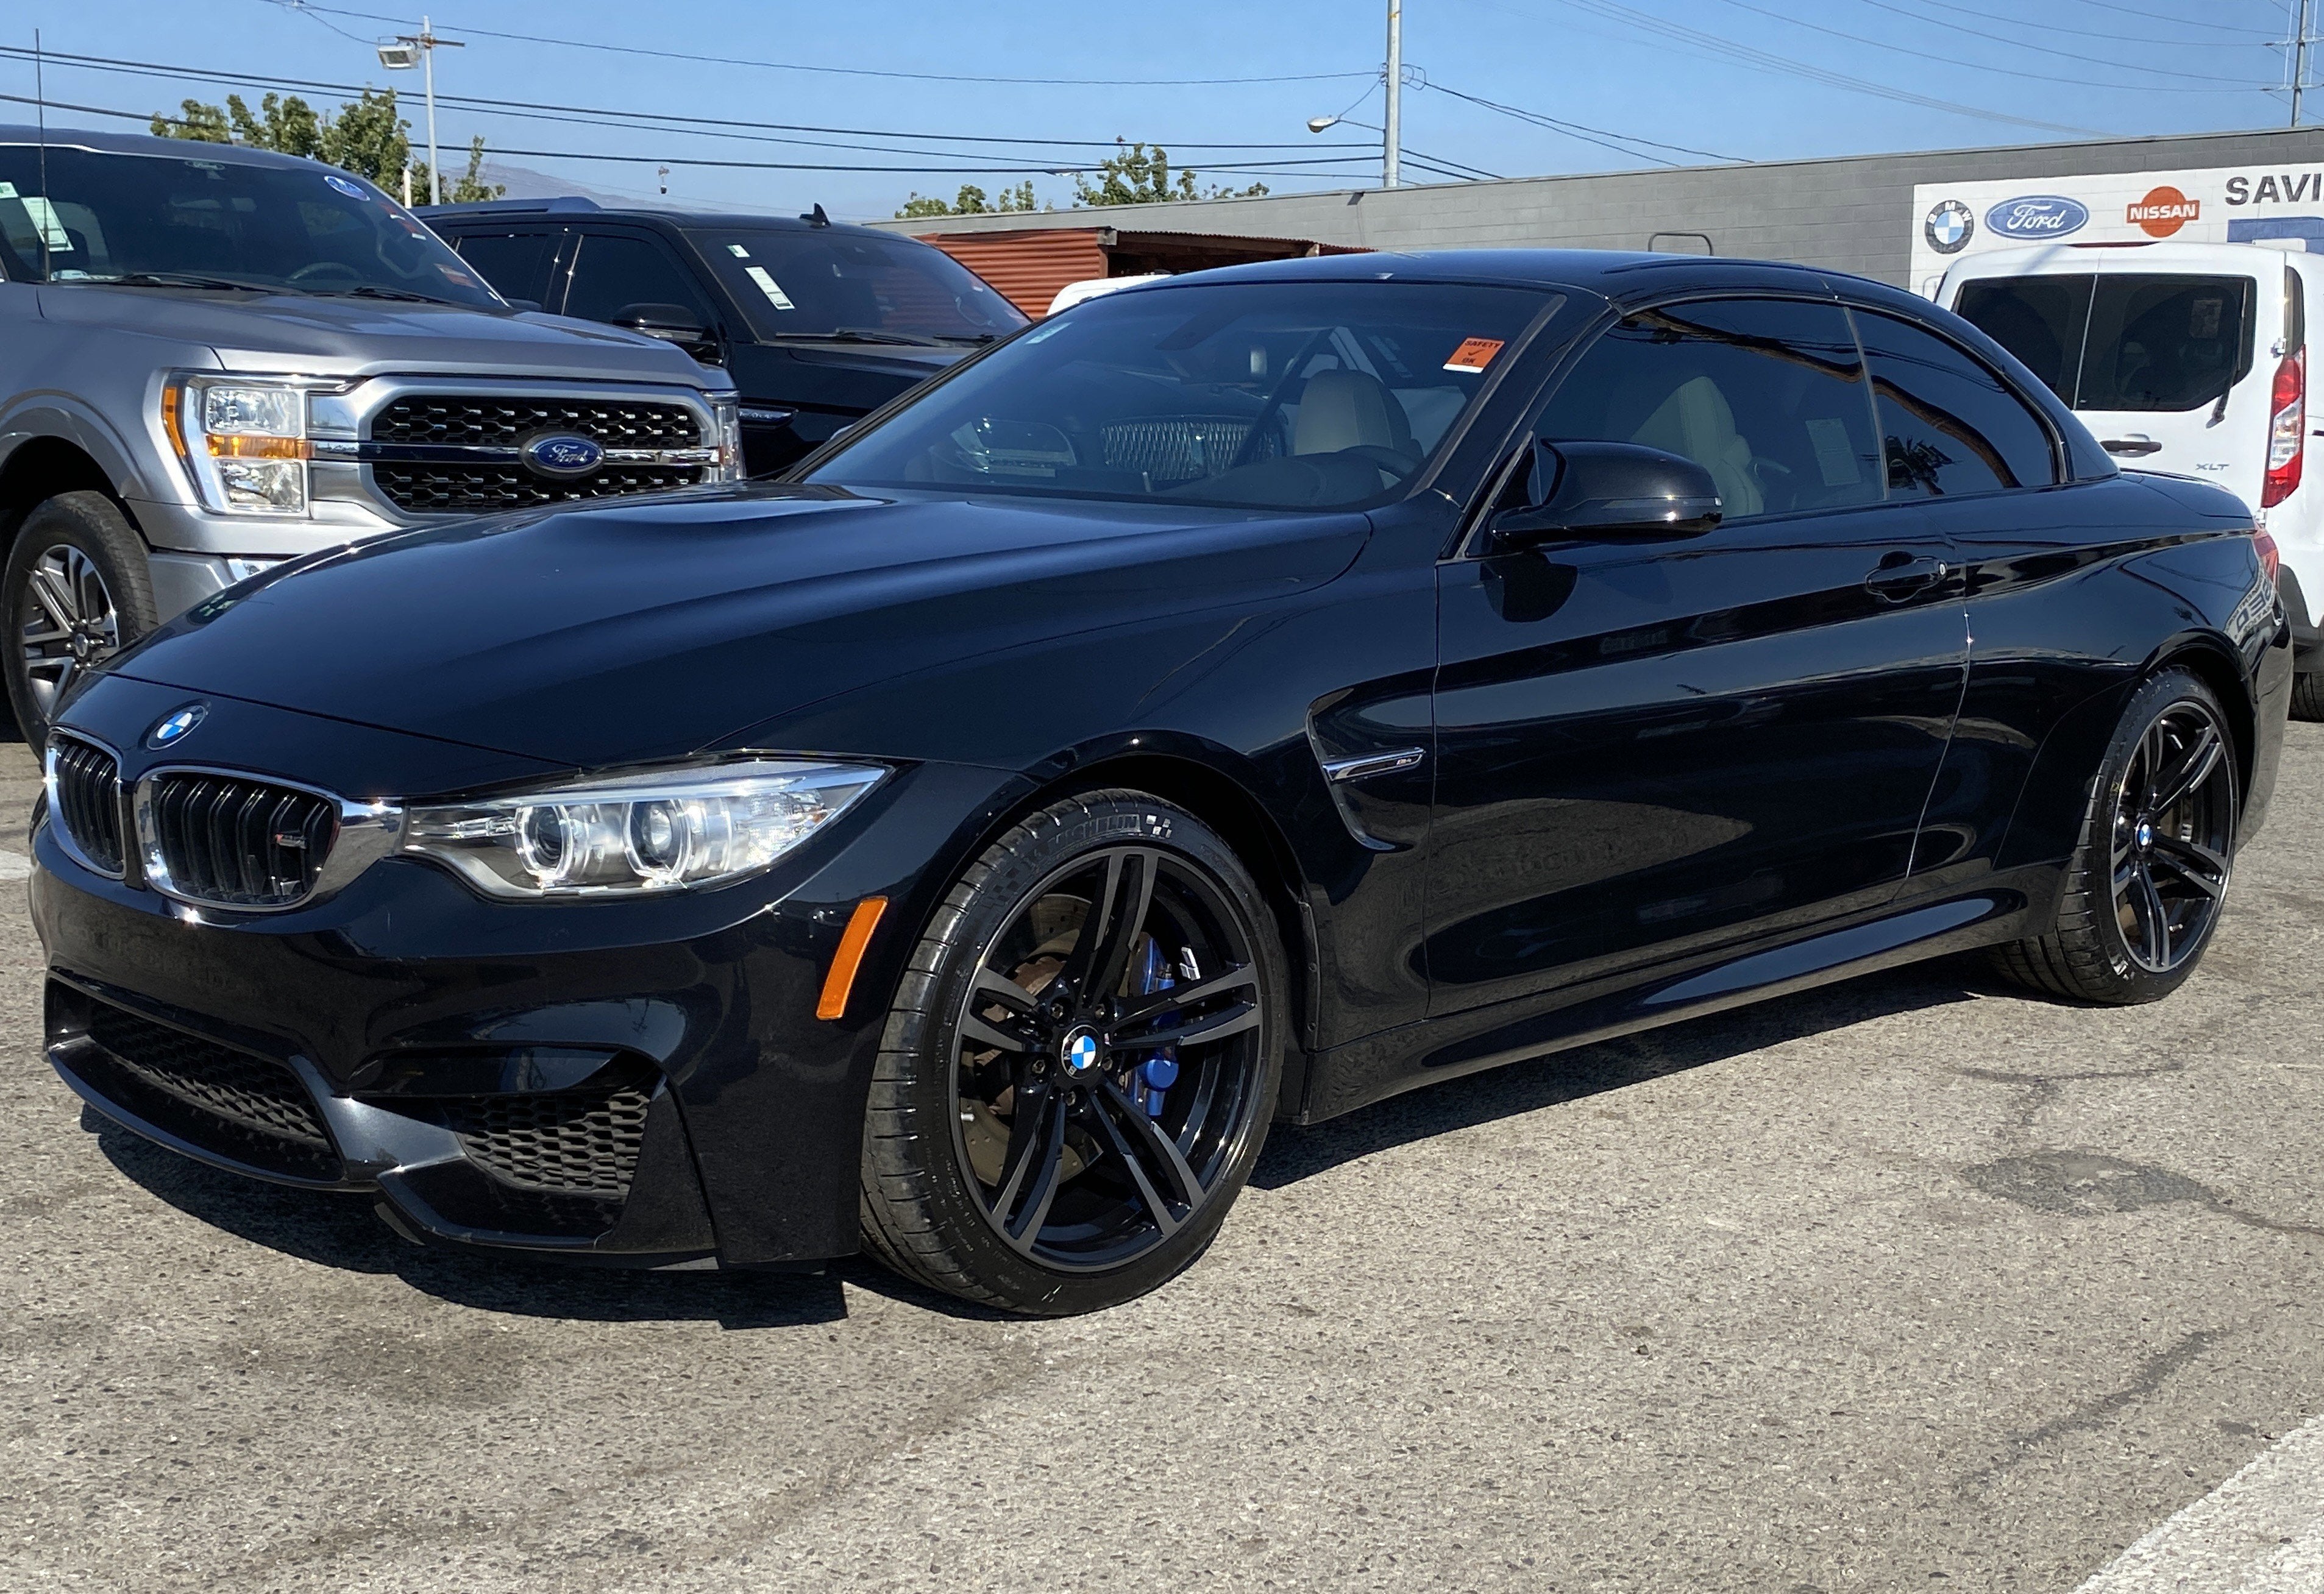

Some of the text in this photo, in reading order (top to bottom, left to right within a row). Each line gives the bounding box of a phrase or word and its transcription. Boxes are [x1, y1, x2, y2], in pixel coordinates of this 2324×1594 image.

[2225, 173, 2324, 205] SAVI
[1927, 201, 1973, 224] BMW
[2006, 204, 2067, 229] Ford
[2130, 204, 2195, 220] NISSAN
[1465, 341, 1501, 349] SAFETY
[549, 444, 588, 464] Ford
